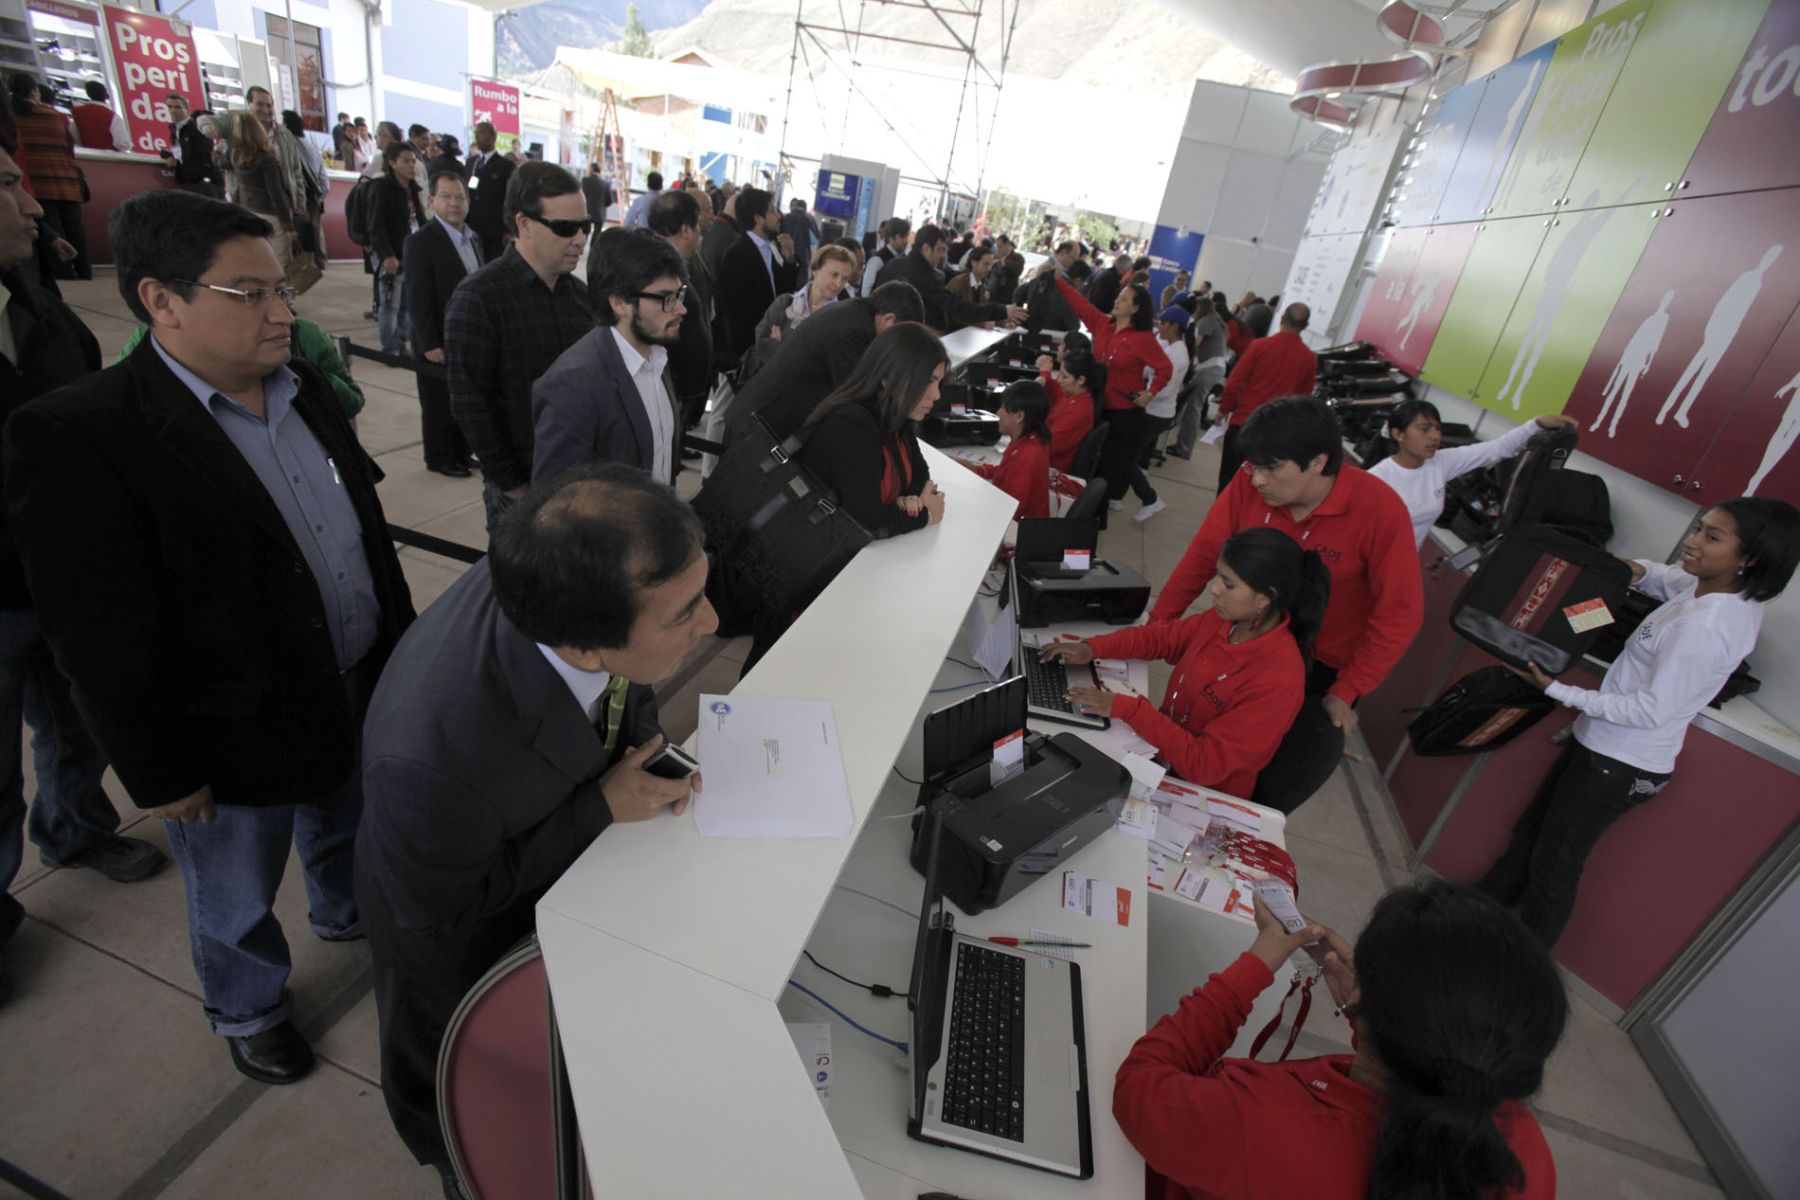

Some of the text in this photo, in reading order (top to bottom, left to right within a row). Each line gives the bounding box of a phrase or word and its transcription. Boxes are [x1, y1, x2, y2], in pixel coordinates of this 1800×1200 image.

[114, 21, 191, 64] Pros
[123, 61, 190, 92] peri
[1728, 43, 1800, 113] to
[474, 85, 517, 104] Rumbo
[496, 102, 518, 115] a la
[139, 131, 167, 151] de
[1314, 543, 1342, 562] CADE
